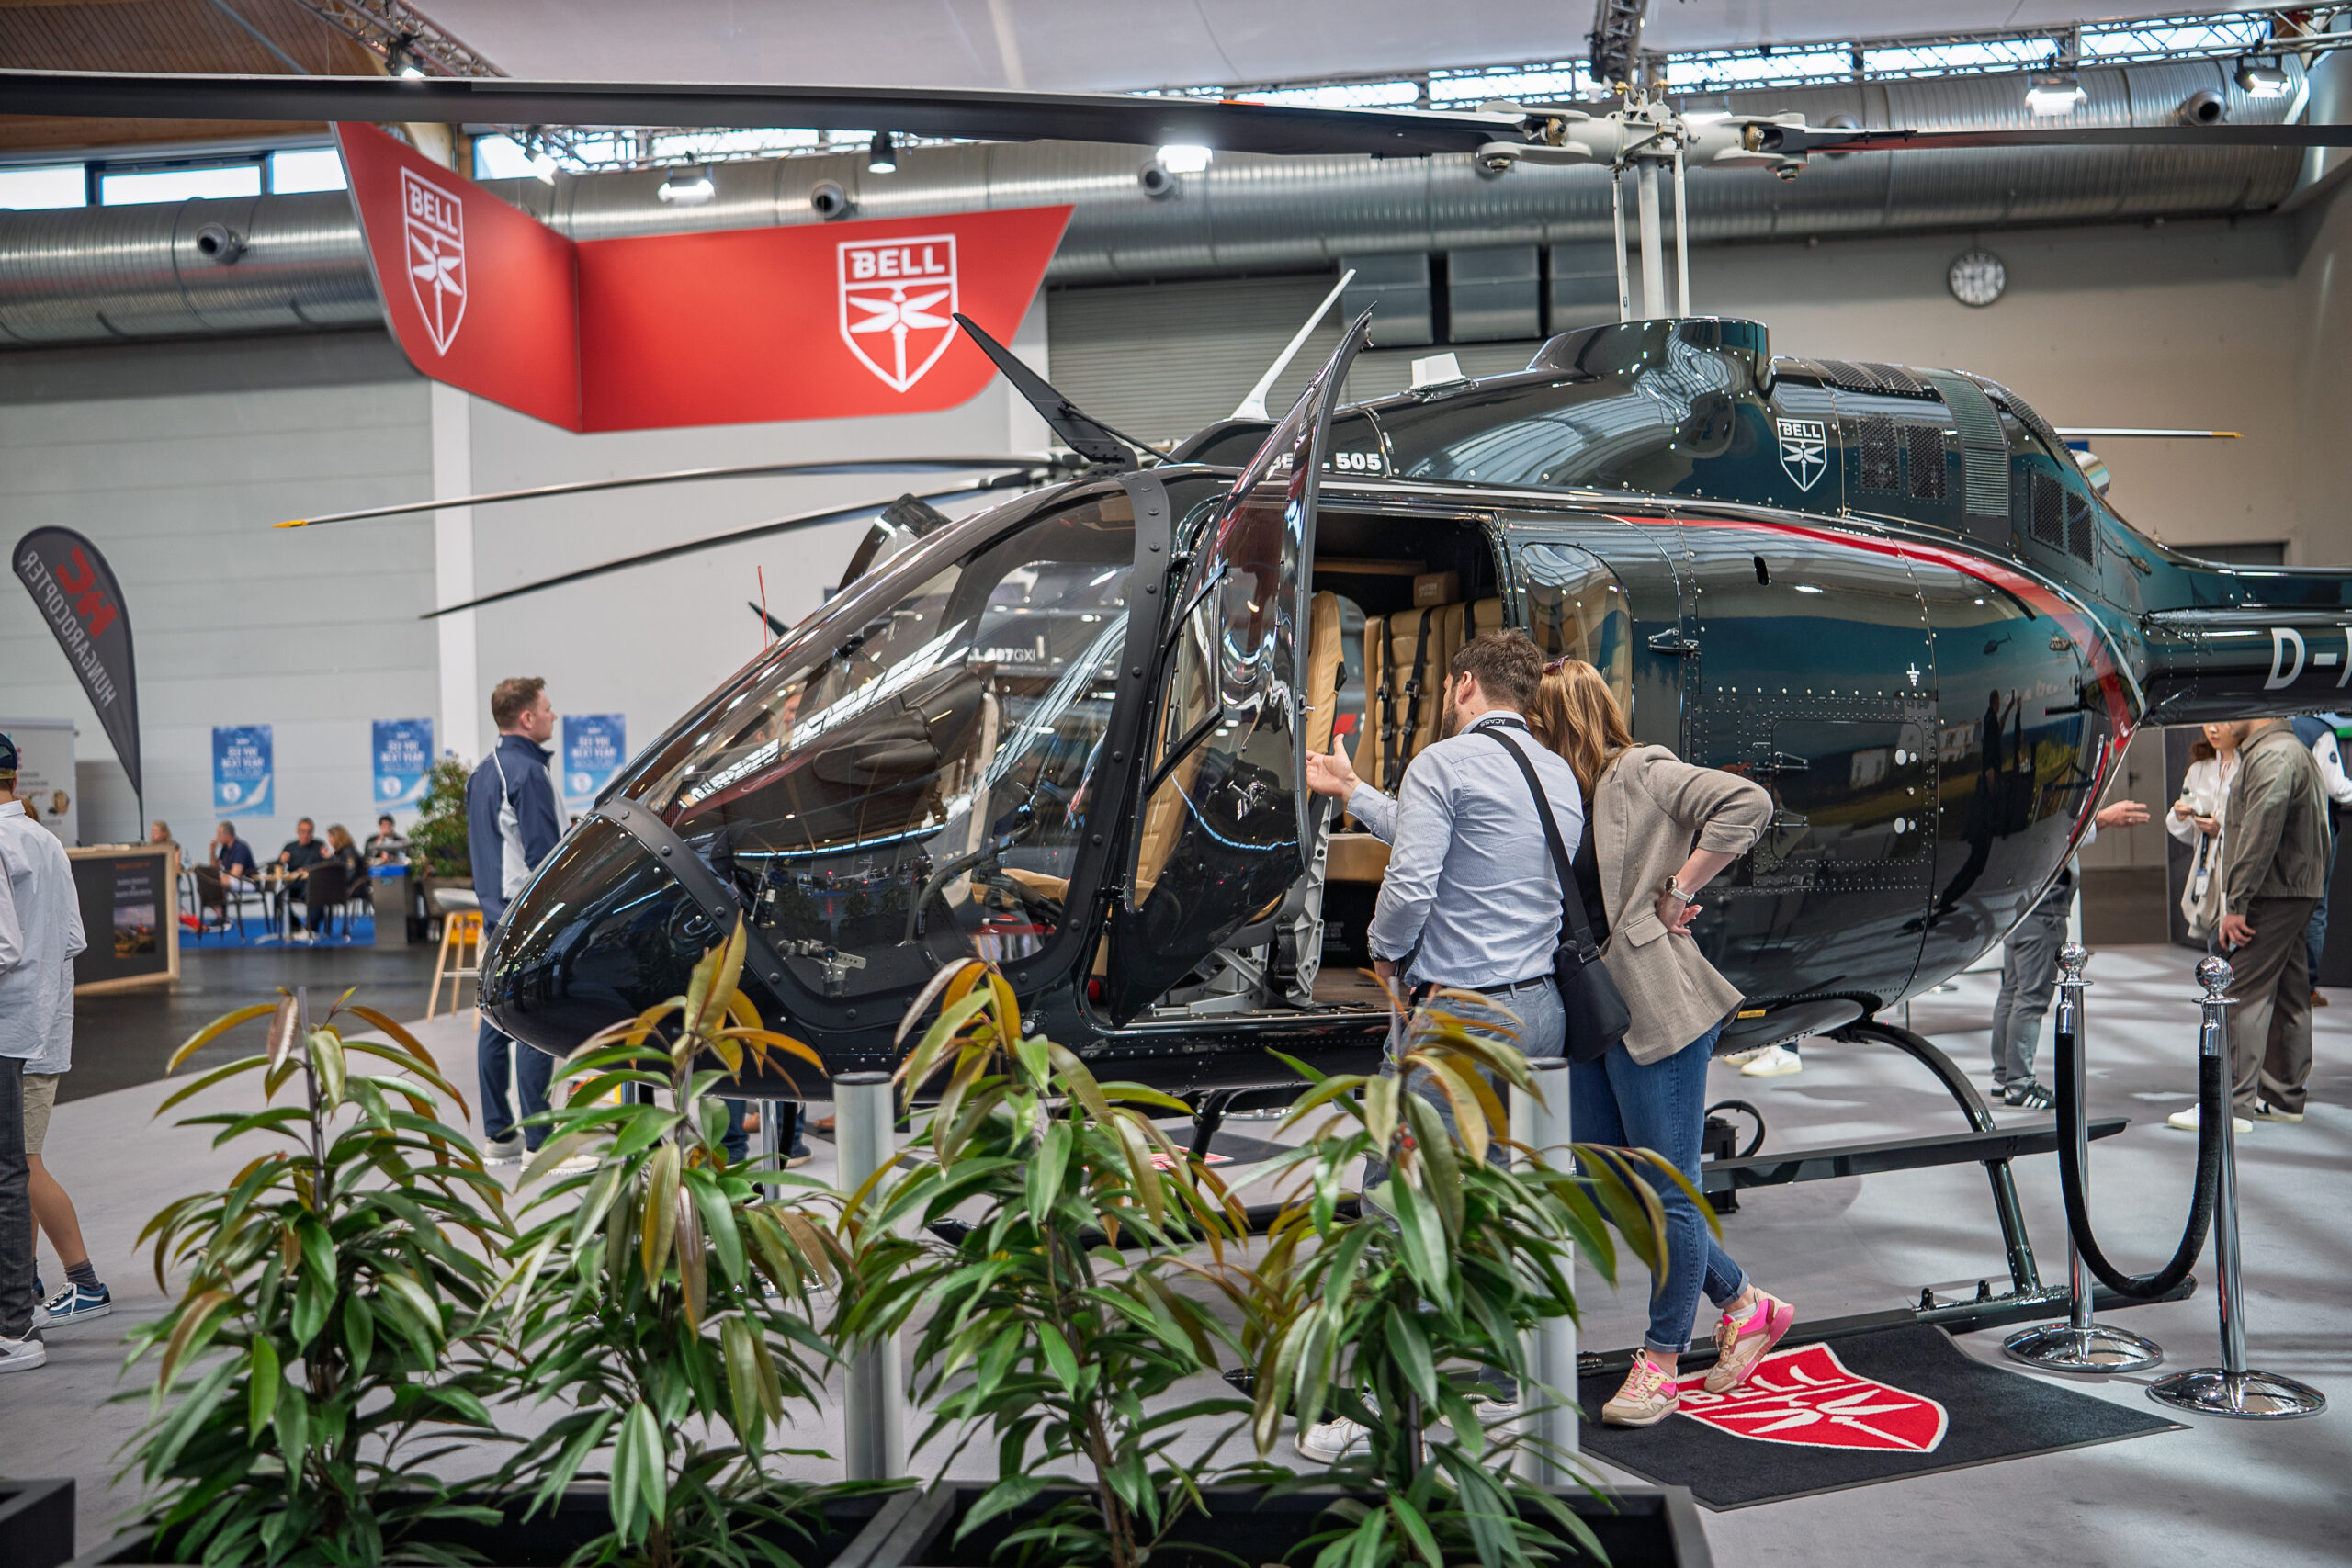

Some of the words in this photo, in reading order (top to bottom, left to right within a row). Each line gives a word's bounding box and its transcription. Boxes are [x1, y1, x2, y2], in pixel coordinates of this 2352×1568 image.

[408, 181, 458, 235] BELL
[850, 245, 945, 279] BELL
[1782, 423, 1821, 438] BELL
[1335, 452, 1382, 471] 505
[2263, 627, 2352, 690] D-
[388, 740, 401, 750] SEE
[404, 740, 419, 750] YOU
[579, 736, 593, 746] SEE
[595, 736, 610, 746] YOU
[228, 746, 241, 756] SEE
[243, 745, 258, 755] YOU
